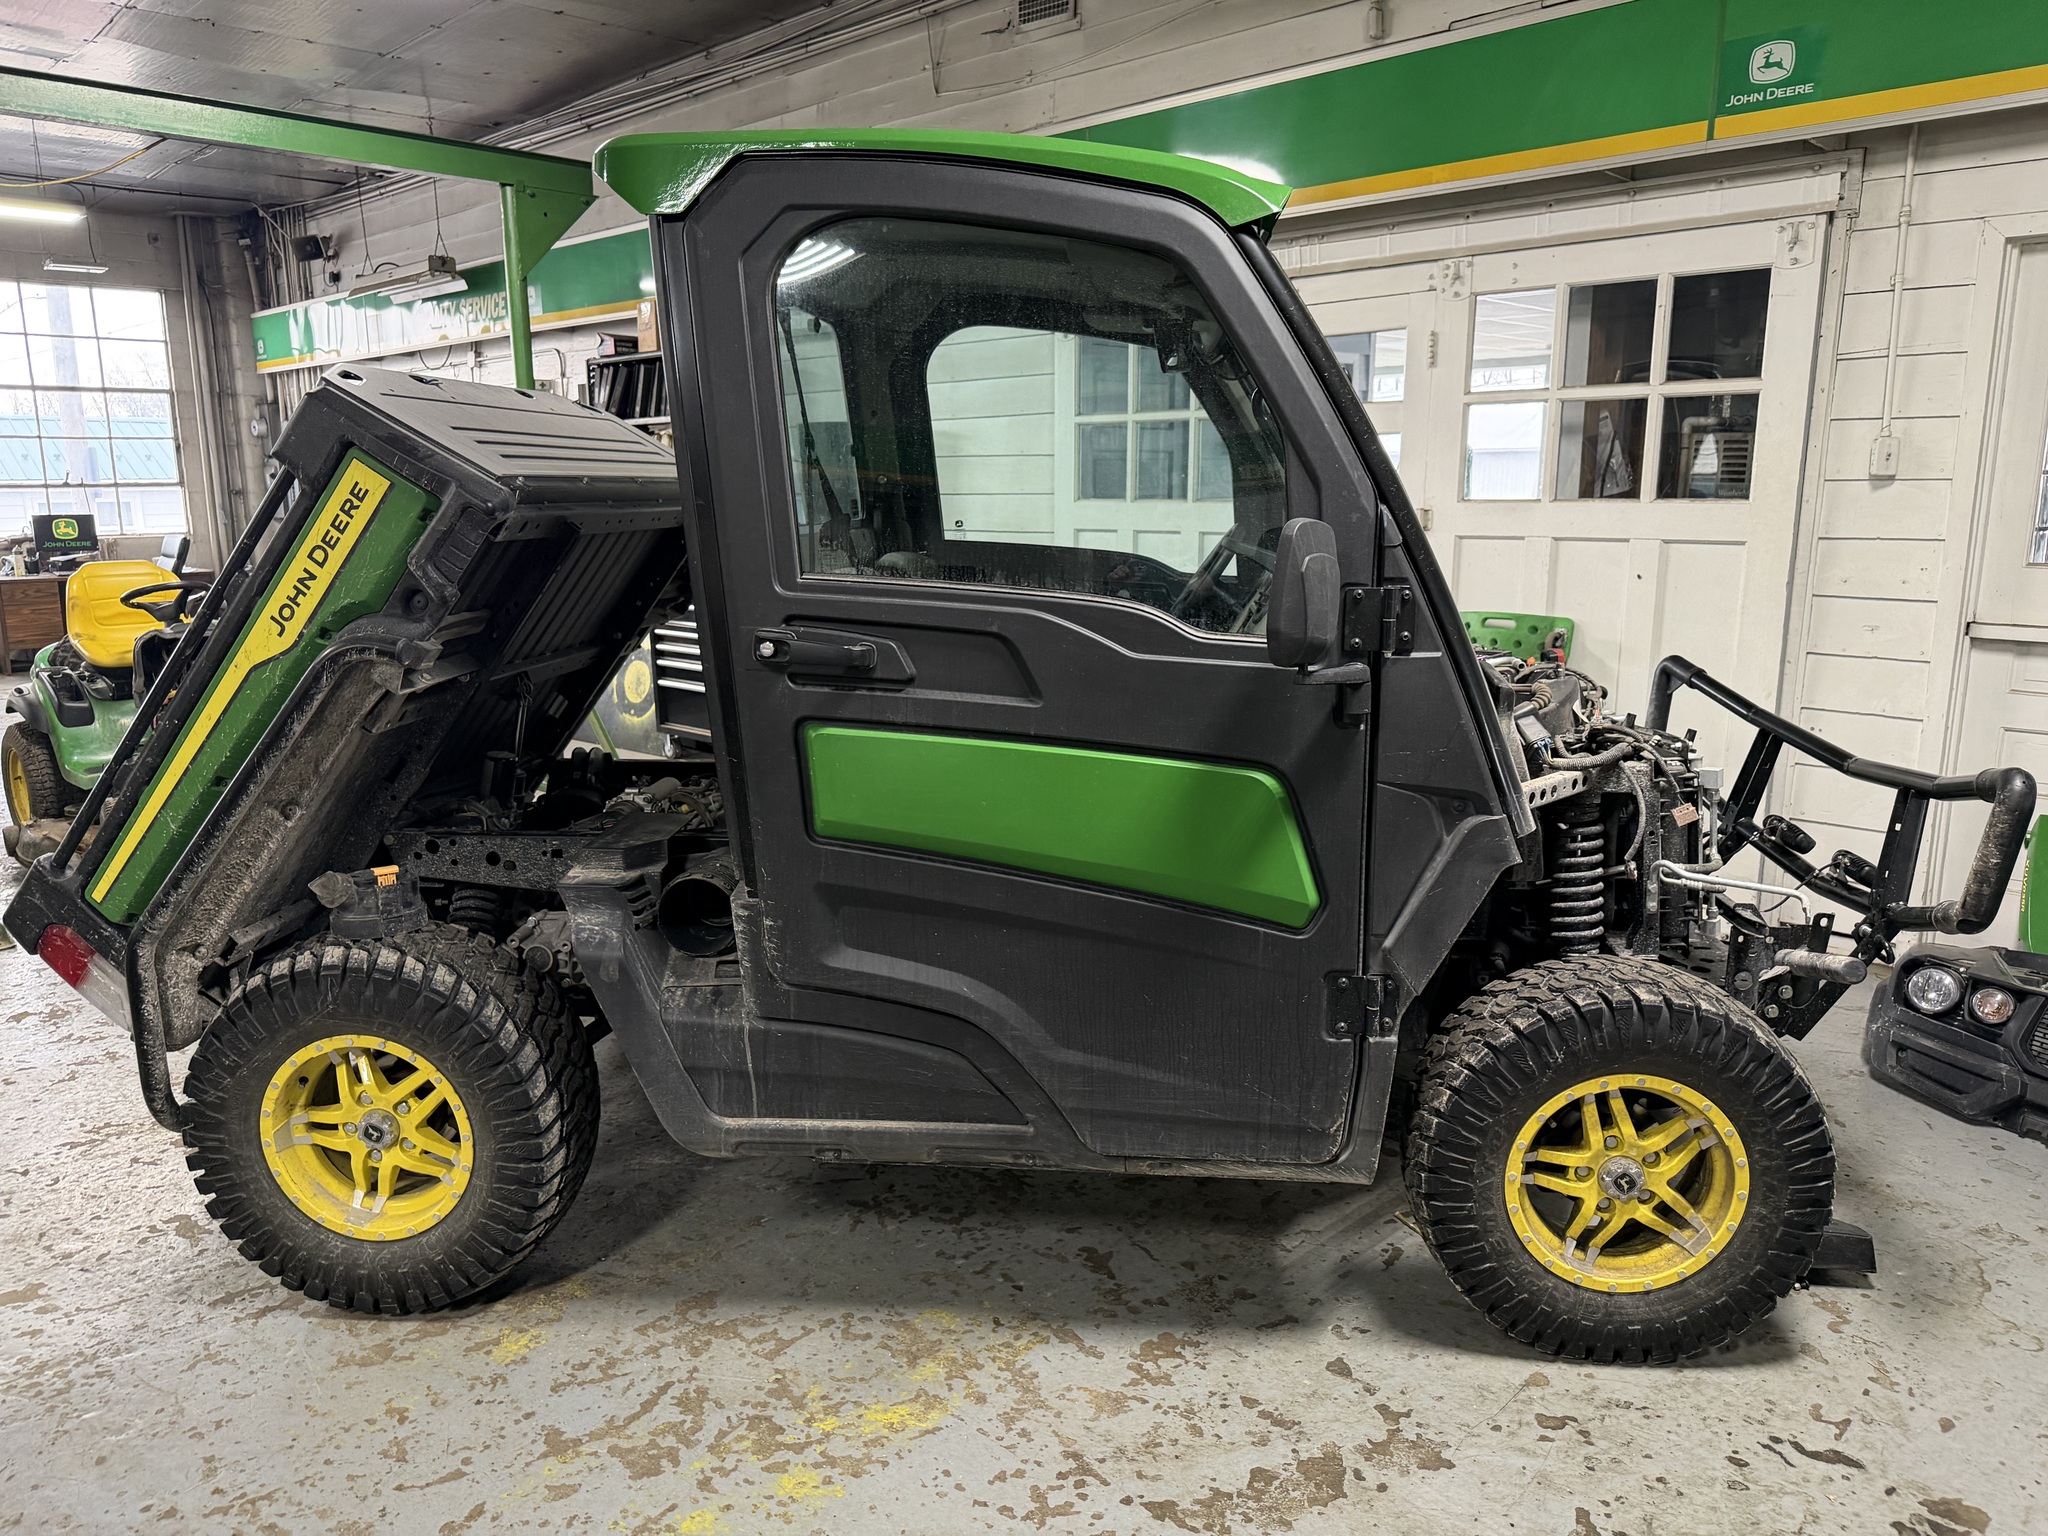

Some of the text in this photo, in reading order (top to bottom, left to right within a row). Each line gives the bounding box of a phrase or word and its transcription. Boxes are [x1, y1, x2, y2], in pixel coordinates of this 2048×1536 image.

[1725, 83, 1815, 107] JOHN DEERE
[459, 291, 507, 321] SERVICE
[65, 540, 92, 548] DEERE
[269, 481, 370, 638] JOHN DEERE
